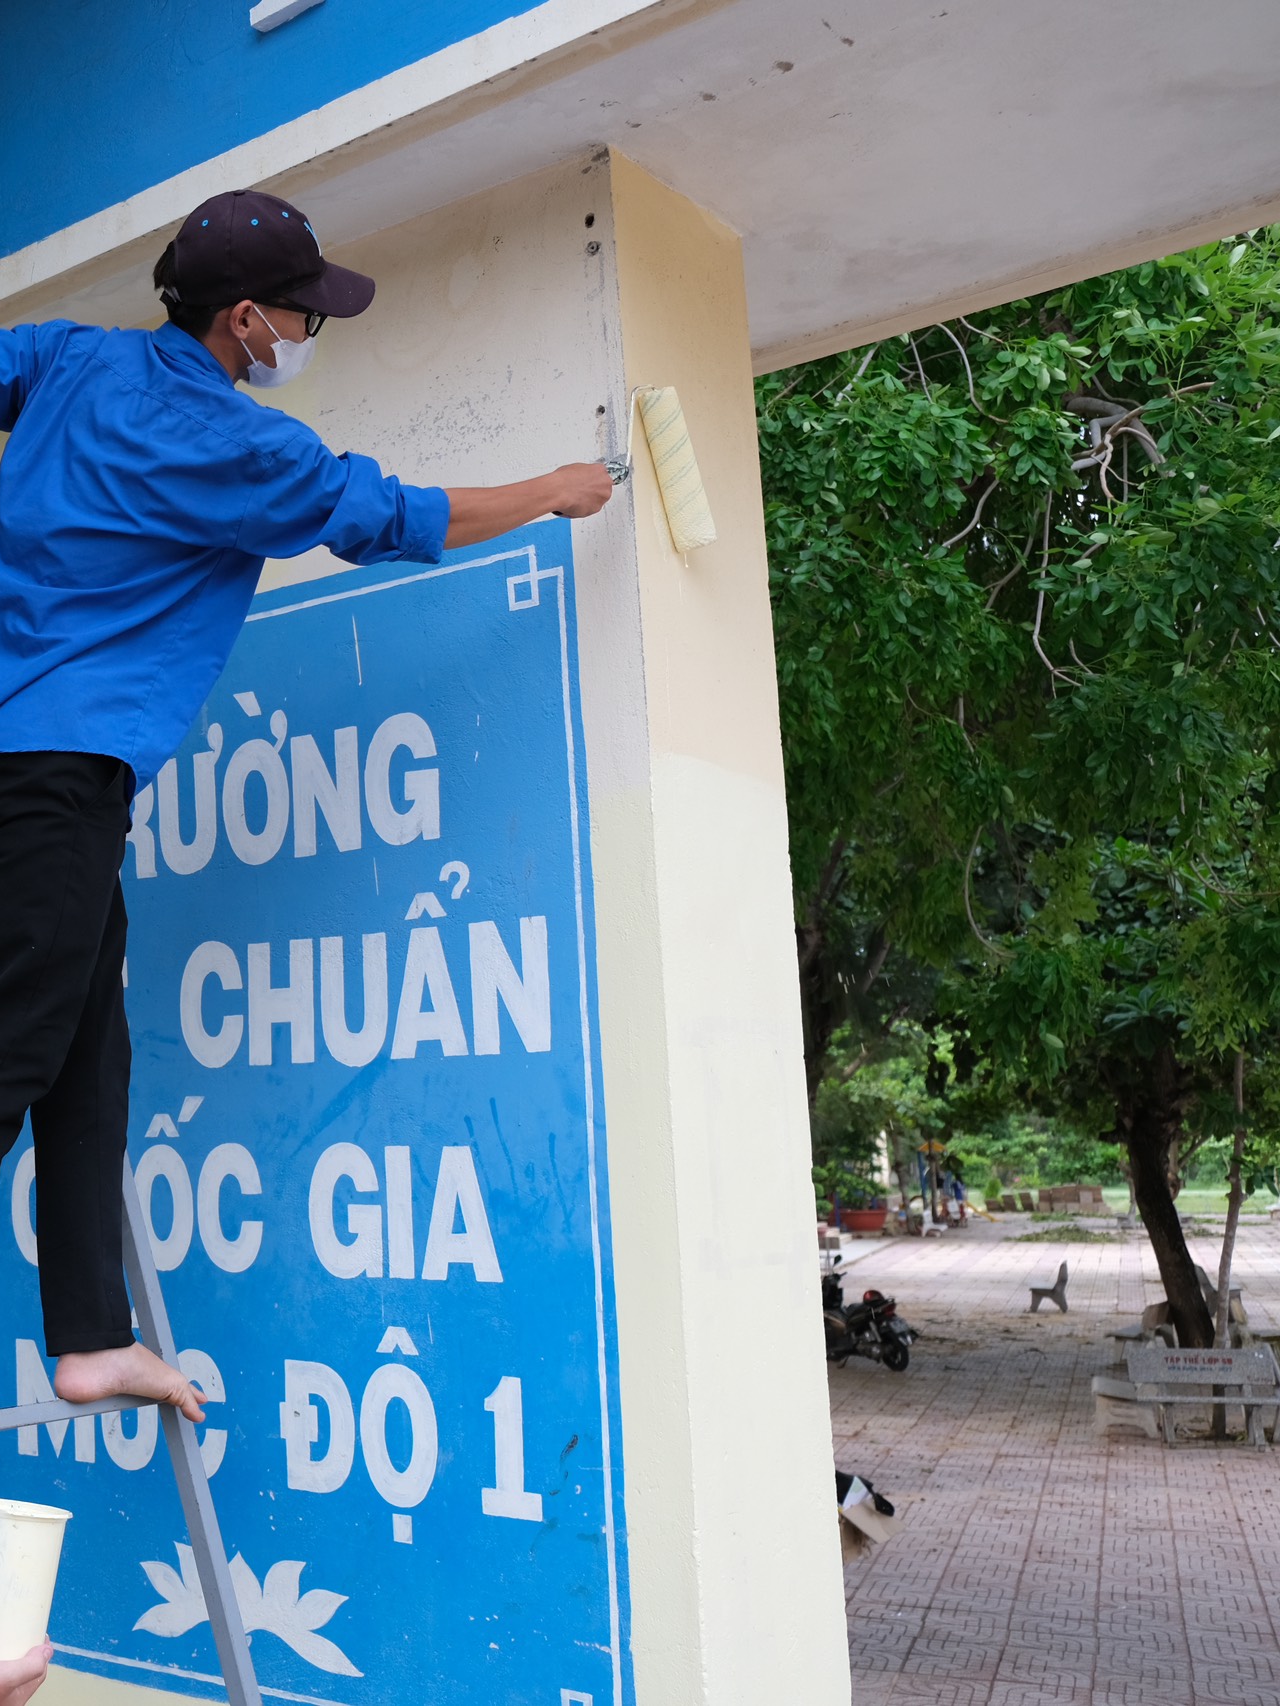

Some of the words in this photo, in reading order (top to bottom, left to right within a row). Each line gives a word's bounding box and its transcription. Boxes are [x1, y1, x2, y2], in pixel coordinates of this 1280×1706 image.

[179, 860, 552, 1068] CHUẨN
[308, 1141, 504, 1283] GIA
[279, 1325, 439, 1544] ĐỘ
[481, 1376, 543, 1522] 1
